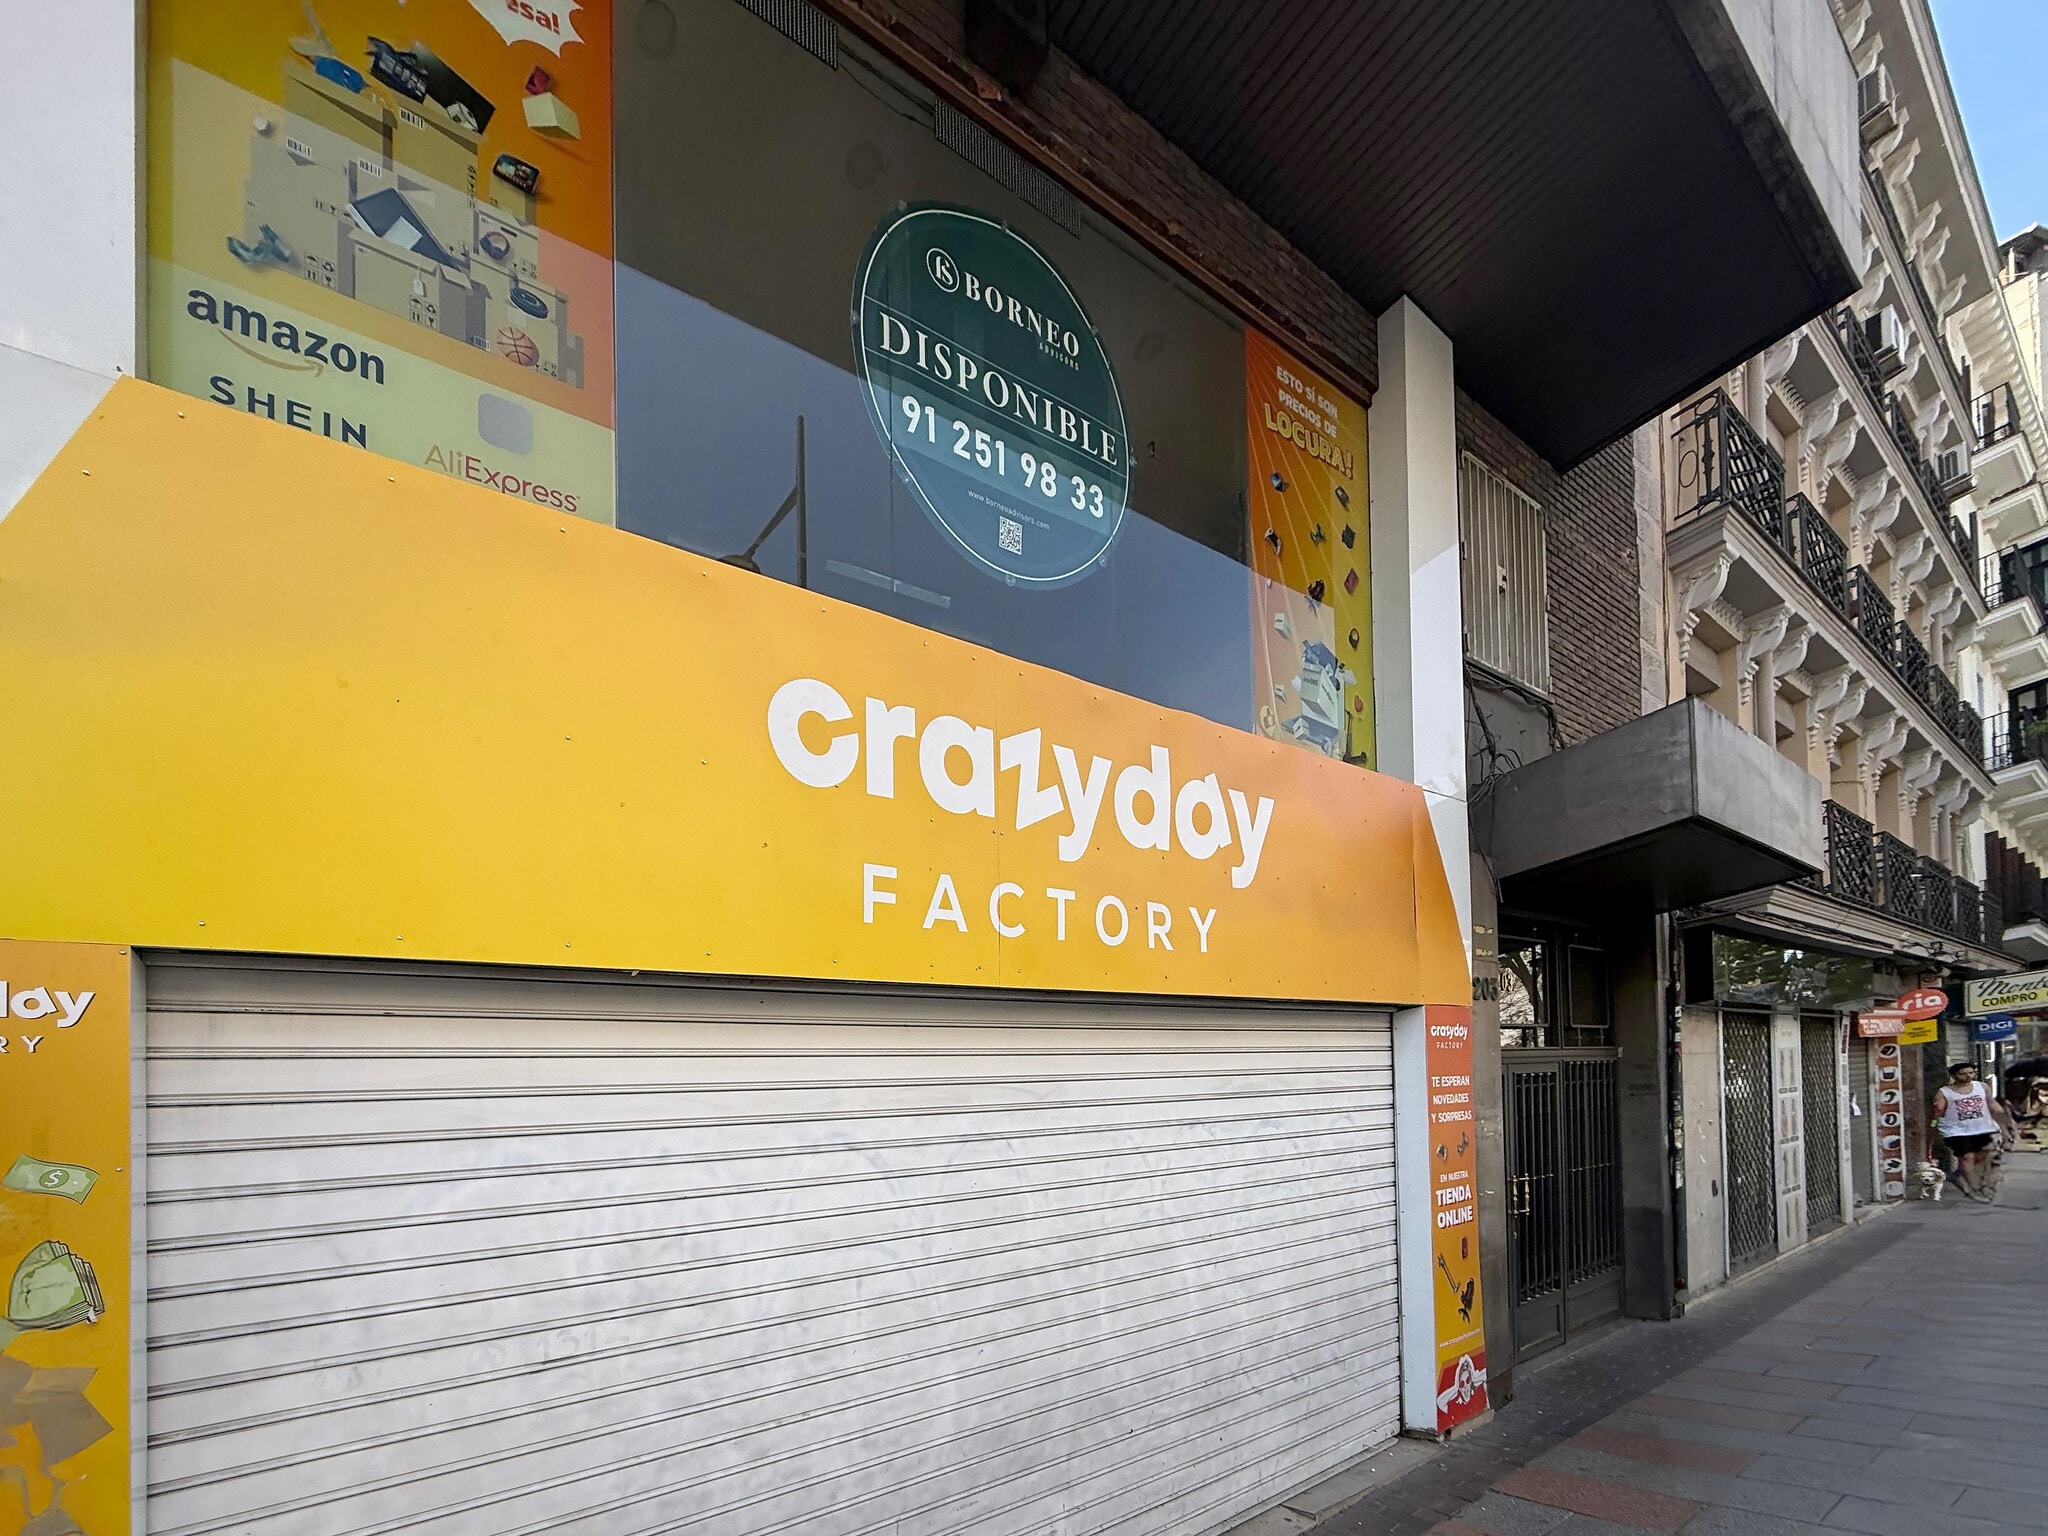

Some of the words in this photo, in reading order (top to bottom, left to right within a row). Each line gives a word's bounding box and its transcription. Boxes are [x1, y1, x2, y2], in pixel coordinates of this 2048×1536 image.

[188, 289, 385, 385] amazon
[964, 272, 1080, 357] BORNEO
[1039, 342, 1080, 372] ADVISORS
[209, 375, 368, 449] SHEIN
[879, 311, 1118, 466] DISPONIBLE
[1276, 365, 1303, 394] ESTO
[1317, 395, 1338, 419] SON
[1278, 388, 1322, 428] PRECIOS
[1324, 420, 1338, 439] DE
[902, 395, 936, 443] 91
[953, 420, 1006, 477] 251
[1020, 452, 1058, 498] 98
[1070, 476, 1106, 519] 33
[1264, 402, 1354, 480] LOCURA!
[424, 444, 578, 513] AliExpress
[767, 678, 1275, 890] crazyday
[863, 862, 1217, 954] FACTORY
[1982, 991, 2038, 1007] COMPRO
[1436, 1041, 1464, 1049] FACTORY
[1979, 1020, 2013, 1032] DIGI
[1431, 1076, 1441, 1088] TE
[1441, 1075, 1471, 1087] ESPERAN
[1432, 1093, 1470, 1105] NOVEDADES
[1431, 1113, 1437, 1123] Y
[1438, 1110, 1473, 1123] SORPRESAS
[1435, 1184, 1473, 1206] TIENDA
[1440, 1173, 1448, 1183] EN
[1448, 1170, 1469, 1181] NUESTRA
[1437, 1205, 1474, 1229] ONLINE
